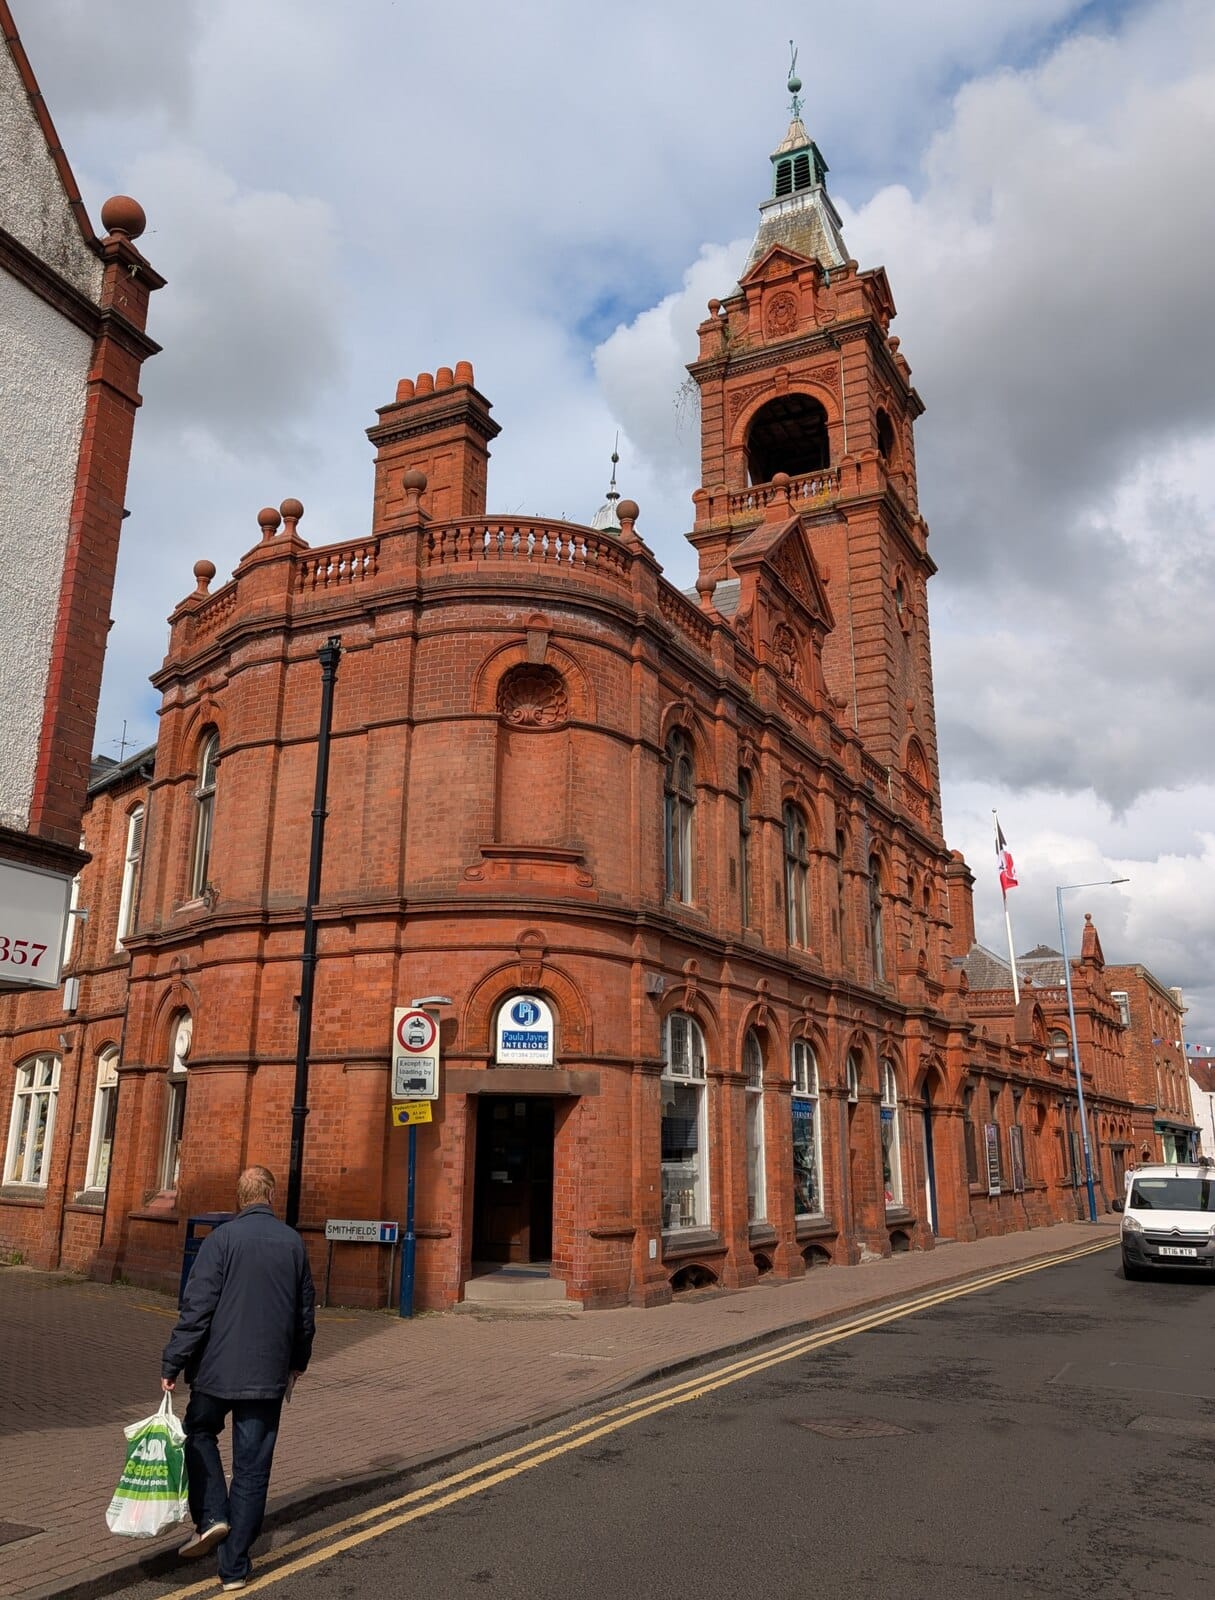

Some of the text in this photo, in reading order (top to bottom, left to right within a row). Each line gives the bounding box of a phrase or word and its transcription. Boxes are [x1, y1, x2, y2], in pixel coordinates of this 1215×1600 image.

[503, 1032, 547, 1042] Paula Jayne
[327, 1225, 377, 1235] SMITHFIELDS
